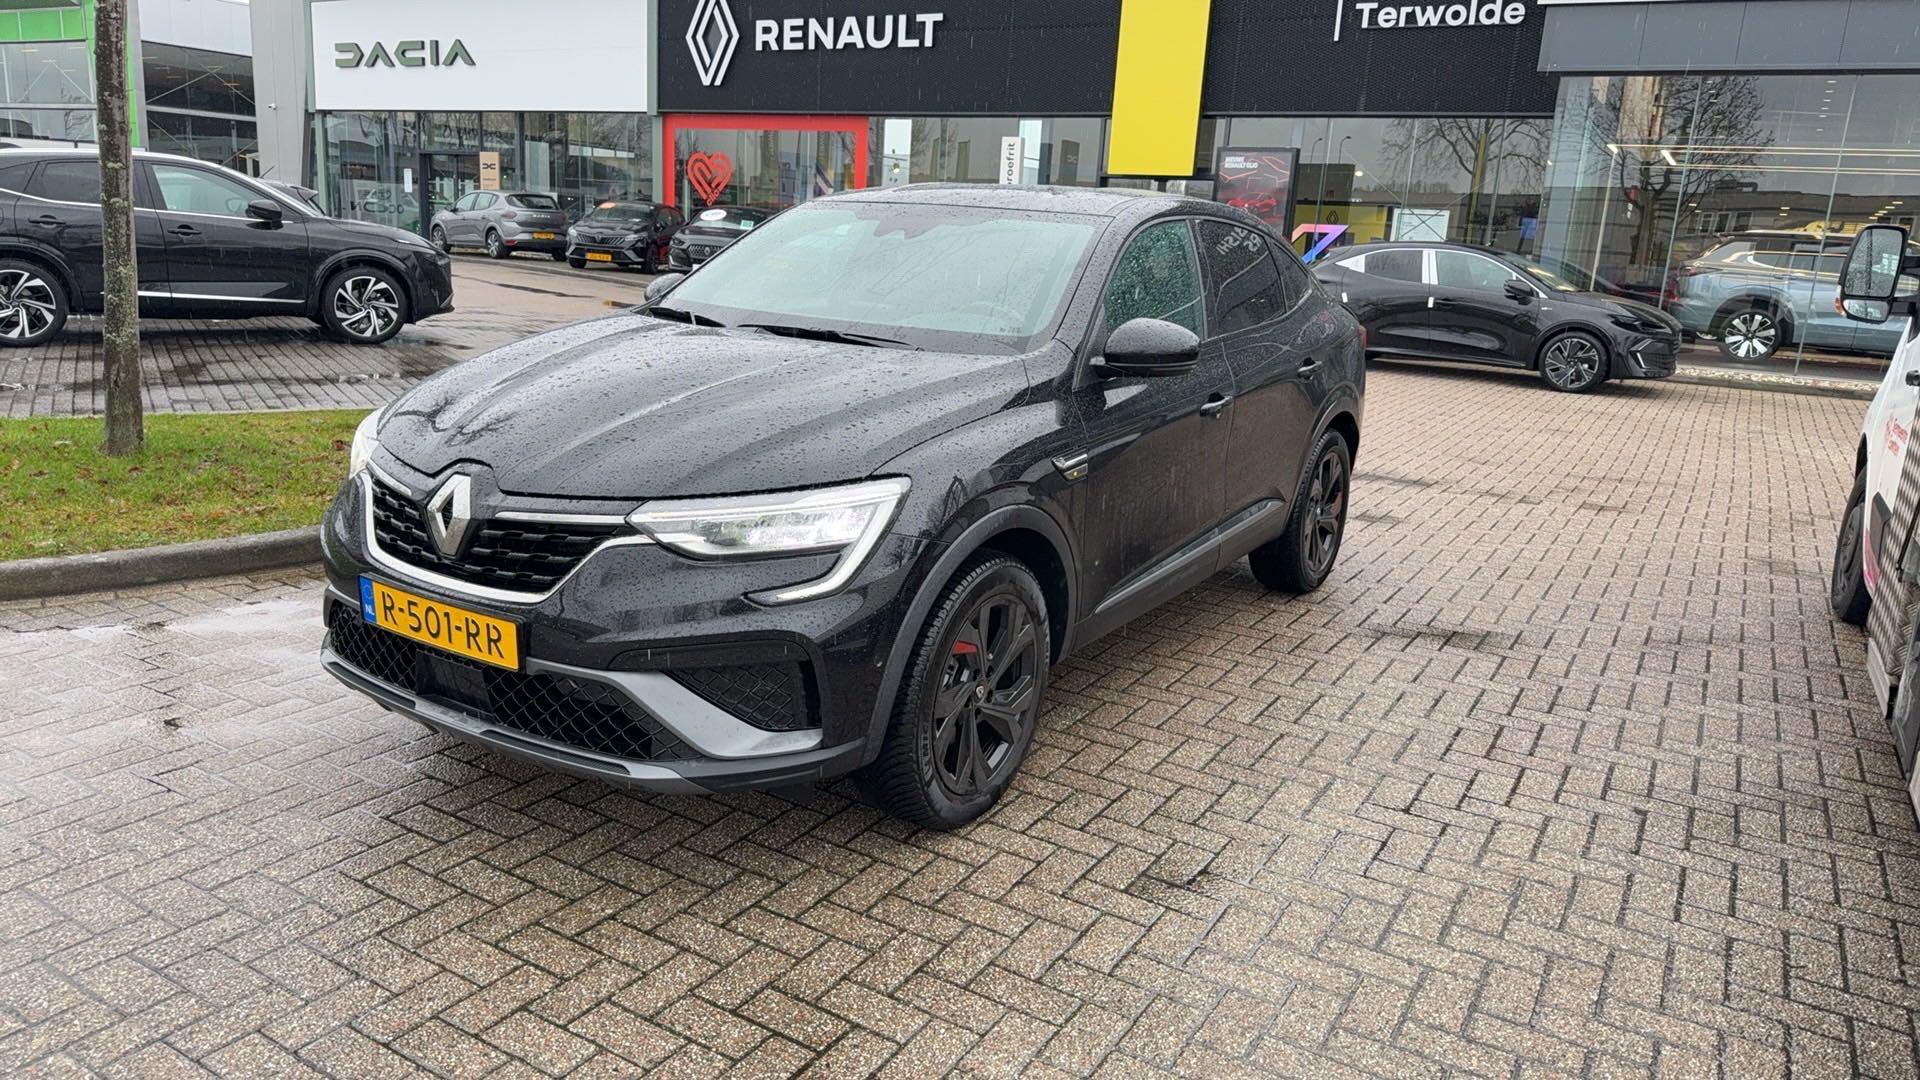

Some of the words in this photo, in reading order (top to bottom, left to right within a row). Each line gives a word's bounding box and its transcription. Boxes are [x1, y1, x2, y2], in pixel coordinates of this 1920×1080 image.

[1356, 0, 1526, 29] Terwolde
[755, 12, 944, 51] RENAULT
[334, 38, 477, 68] DACIA
[364, 604, 375, 616] NL
[382, 591, 505, 659] R-501-RR
